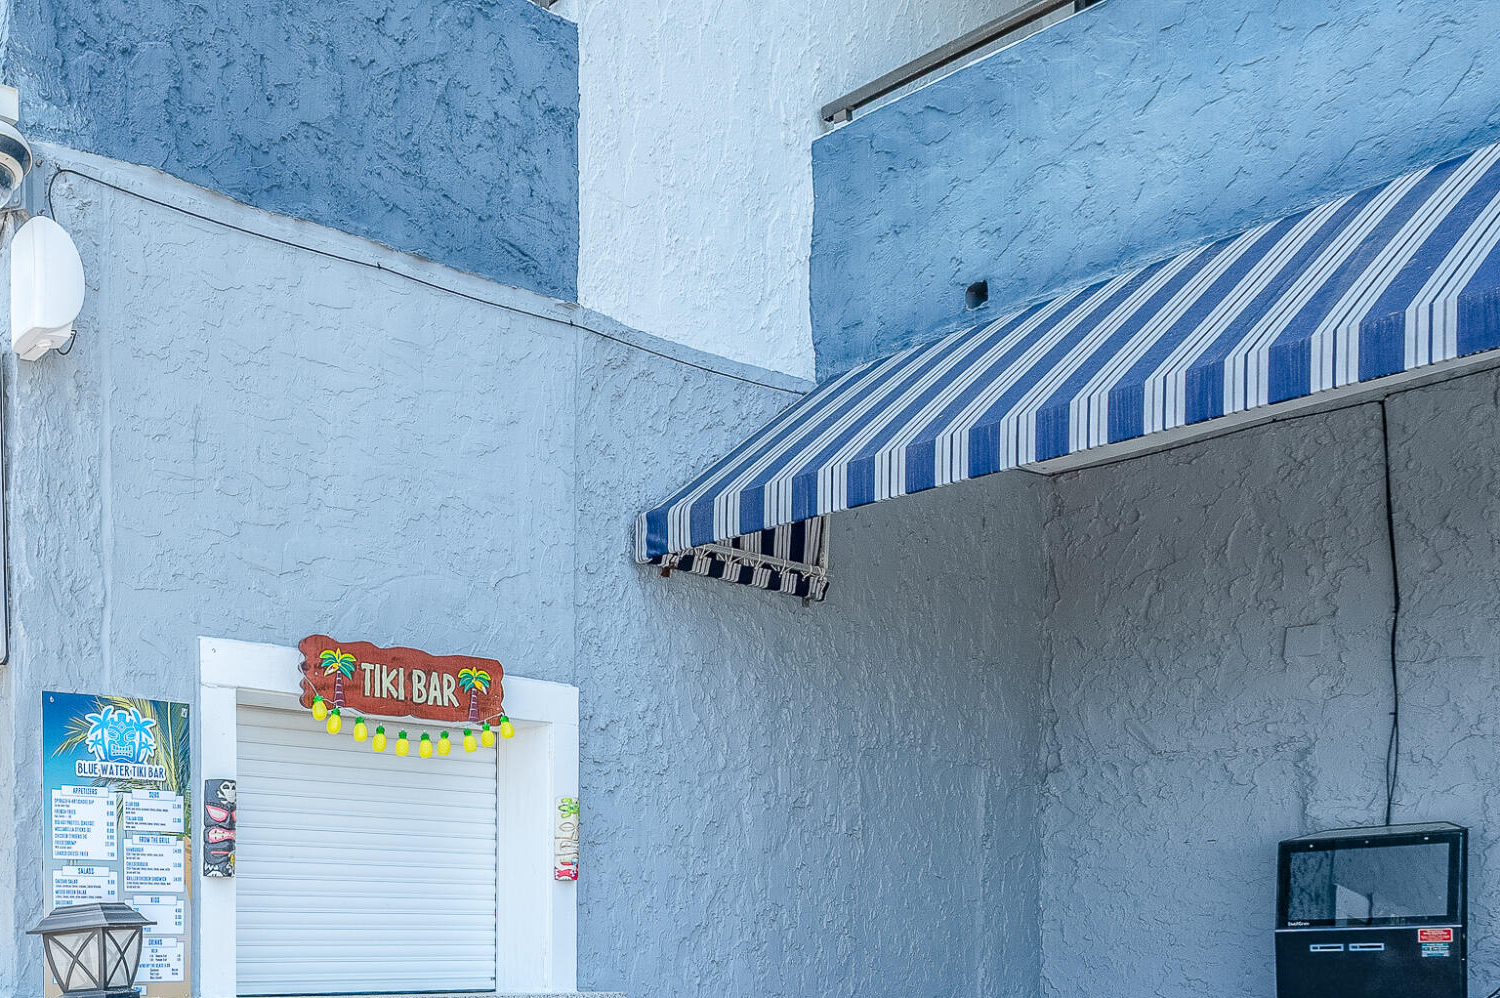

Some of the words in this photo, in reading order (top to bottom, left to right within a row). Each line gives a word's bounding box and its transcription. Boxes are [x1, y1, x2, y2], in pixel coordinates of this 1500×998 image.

[361, 662, 405, 702] TIKI
[412, 669, 460, 708] BAR
[77, 763, 98, 774] BLUE
[100, 764, 130, 777] WATER
[132, 766, 147, 778] TIKI
[148, 768, 165, 779] BAR
